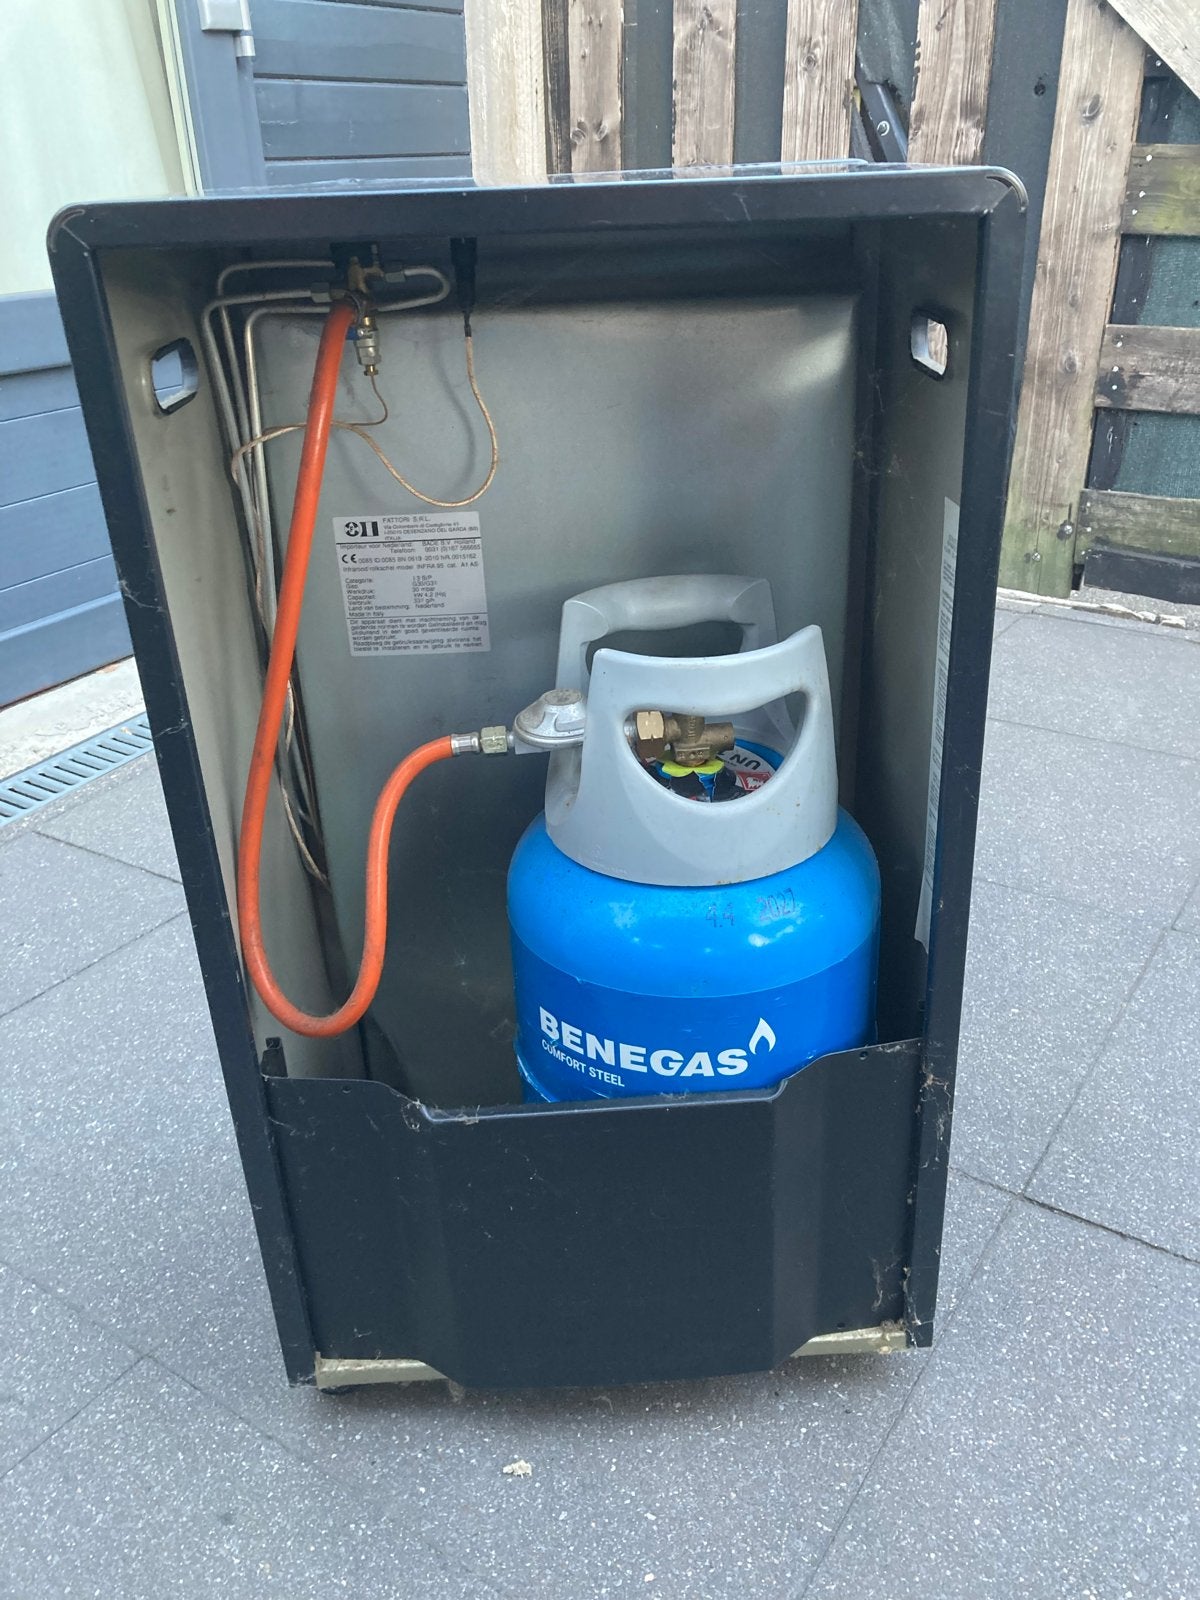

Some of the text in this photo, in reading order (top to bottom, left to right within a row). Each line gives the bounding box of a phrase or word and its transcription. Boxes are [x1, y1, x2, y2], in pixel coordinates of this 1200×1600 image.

[729, 753, 761, 771] UN
[539, 1006, 749, 1077] BENEGAS
[541, 1038, 625, 1087] COMFORT STEEL
